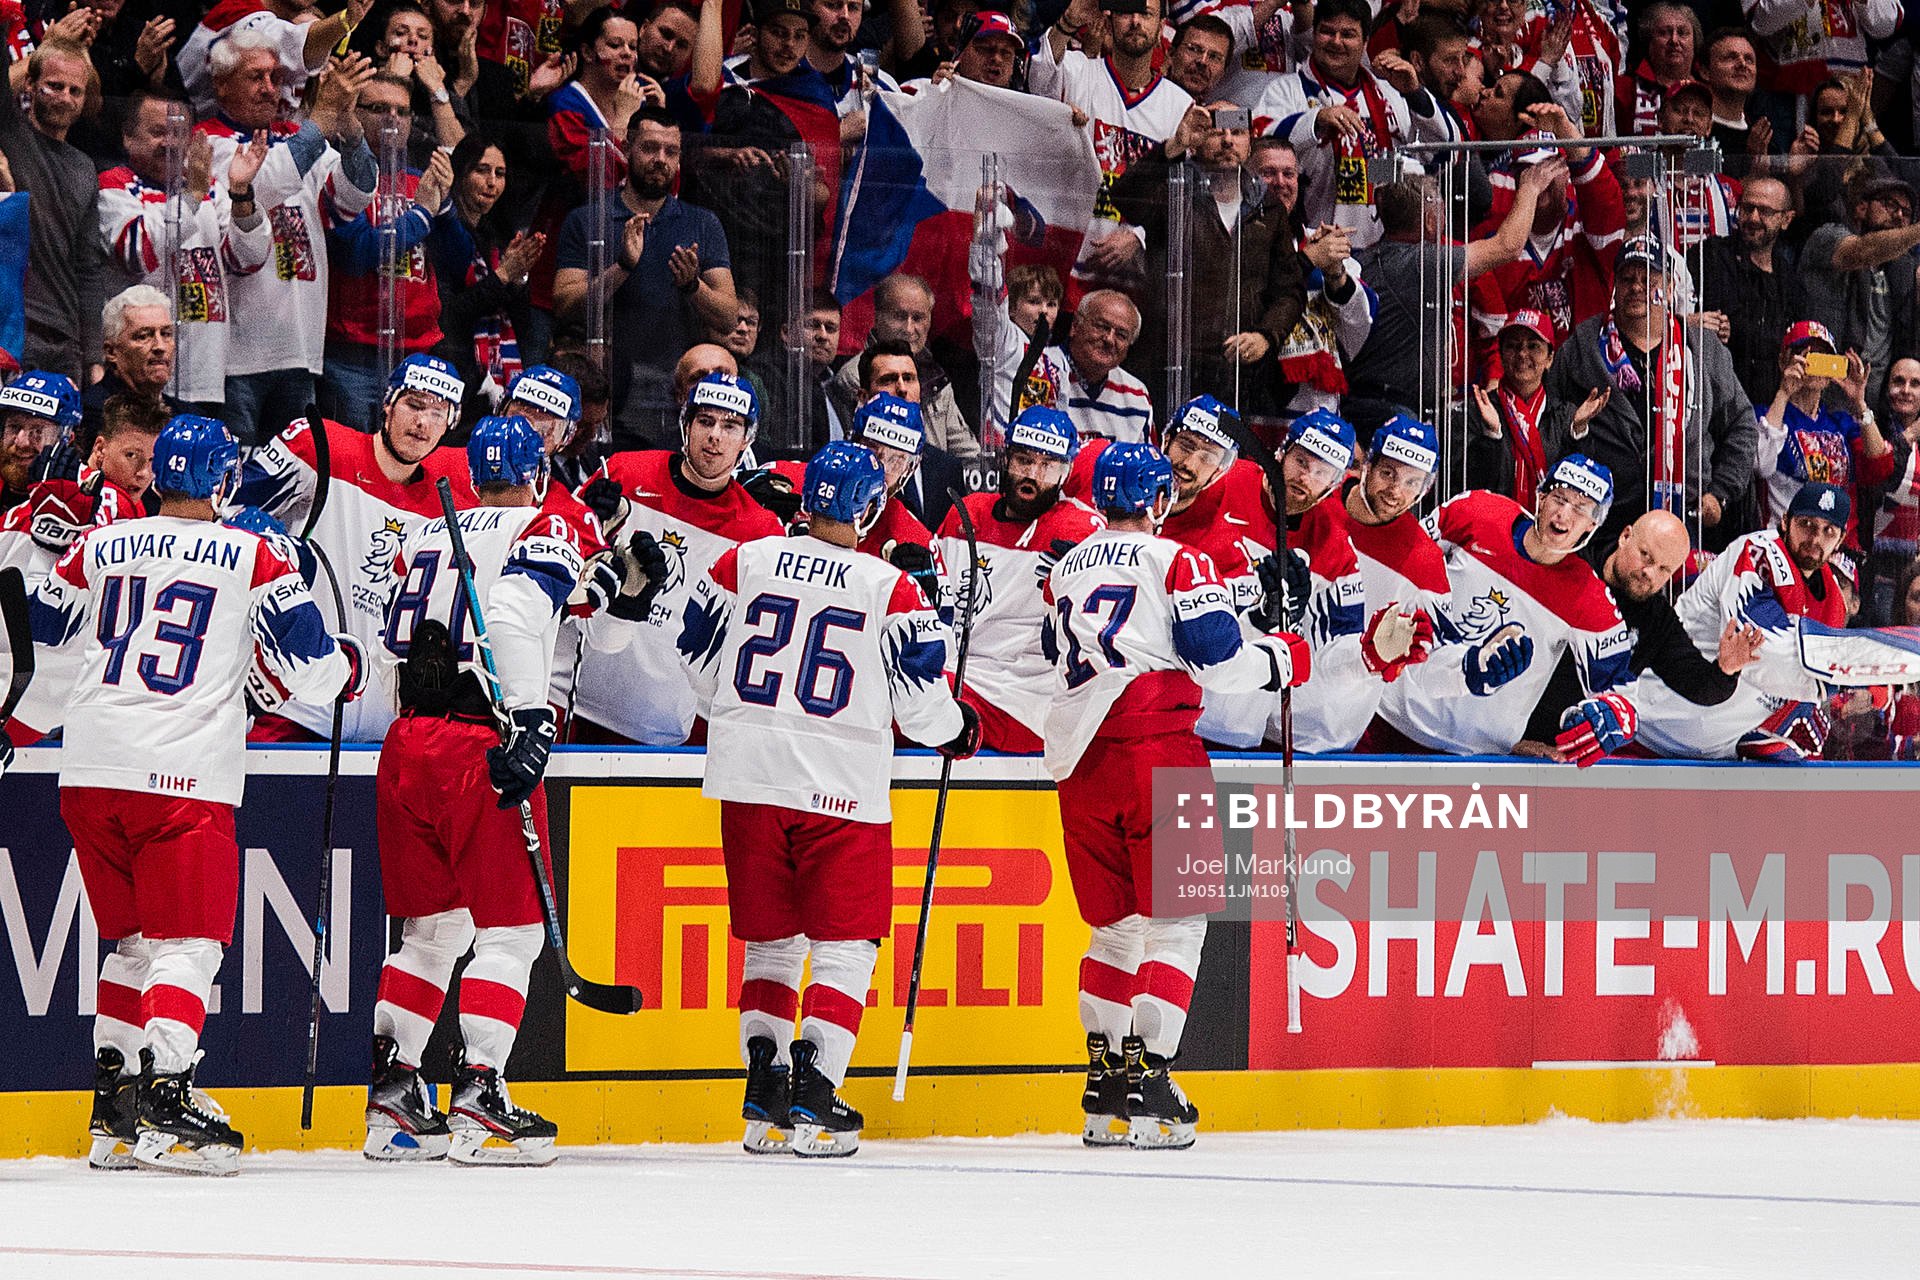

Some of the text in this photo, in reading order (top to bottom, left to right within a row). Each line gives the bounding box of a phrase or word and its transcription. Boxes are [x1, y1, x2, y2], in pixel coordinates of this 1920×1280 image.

[409, 369, 460, 395] ŠKODA
[2, 389, 55, 411] ŠKODA
[518, 383, 567, 411] ŠKODA
[698, 387, 747, 409] ŠKODA
[867, 422, 916, 448] ŠKODA
[1016, 427, 1066, 449] ŠKODA
[1303, 431, 1348, 465] ŠKODA
[168, 455, 187, 472] 43
[487, 446, 502, 462] 81
[1386, 440, 1432, 466] ŠKODA
[818, 482, 836, 500] 26
[1104, 476, 1117, 491] 17
[1560, 465, 1603, 496] ŠKODA
[420, 511, 509, 539] KUALIK
[95, 534, 175, 569] KOVAR
[184, 535, 241, 571] JAN
[530, 542, 581, 573] ŠKOD
[1062, 542, 1146, 577] HRONEK
[775, 552, 852, 588] REPIK
[383, 550, 477, 662] 81
[96, 575, 218, 696] 43
[1057, 585, 1138, 690] 17
[733, 592, 866, 718] 26
[160, 774, 198, 793] IIHF
[822, 794, 859, 814] IIHF
[614, 847, 1053, 1010] PILLI
